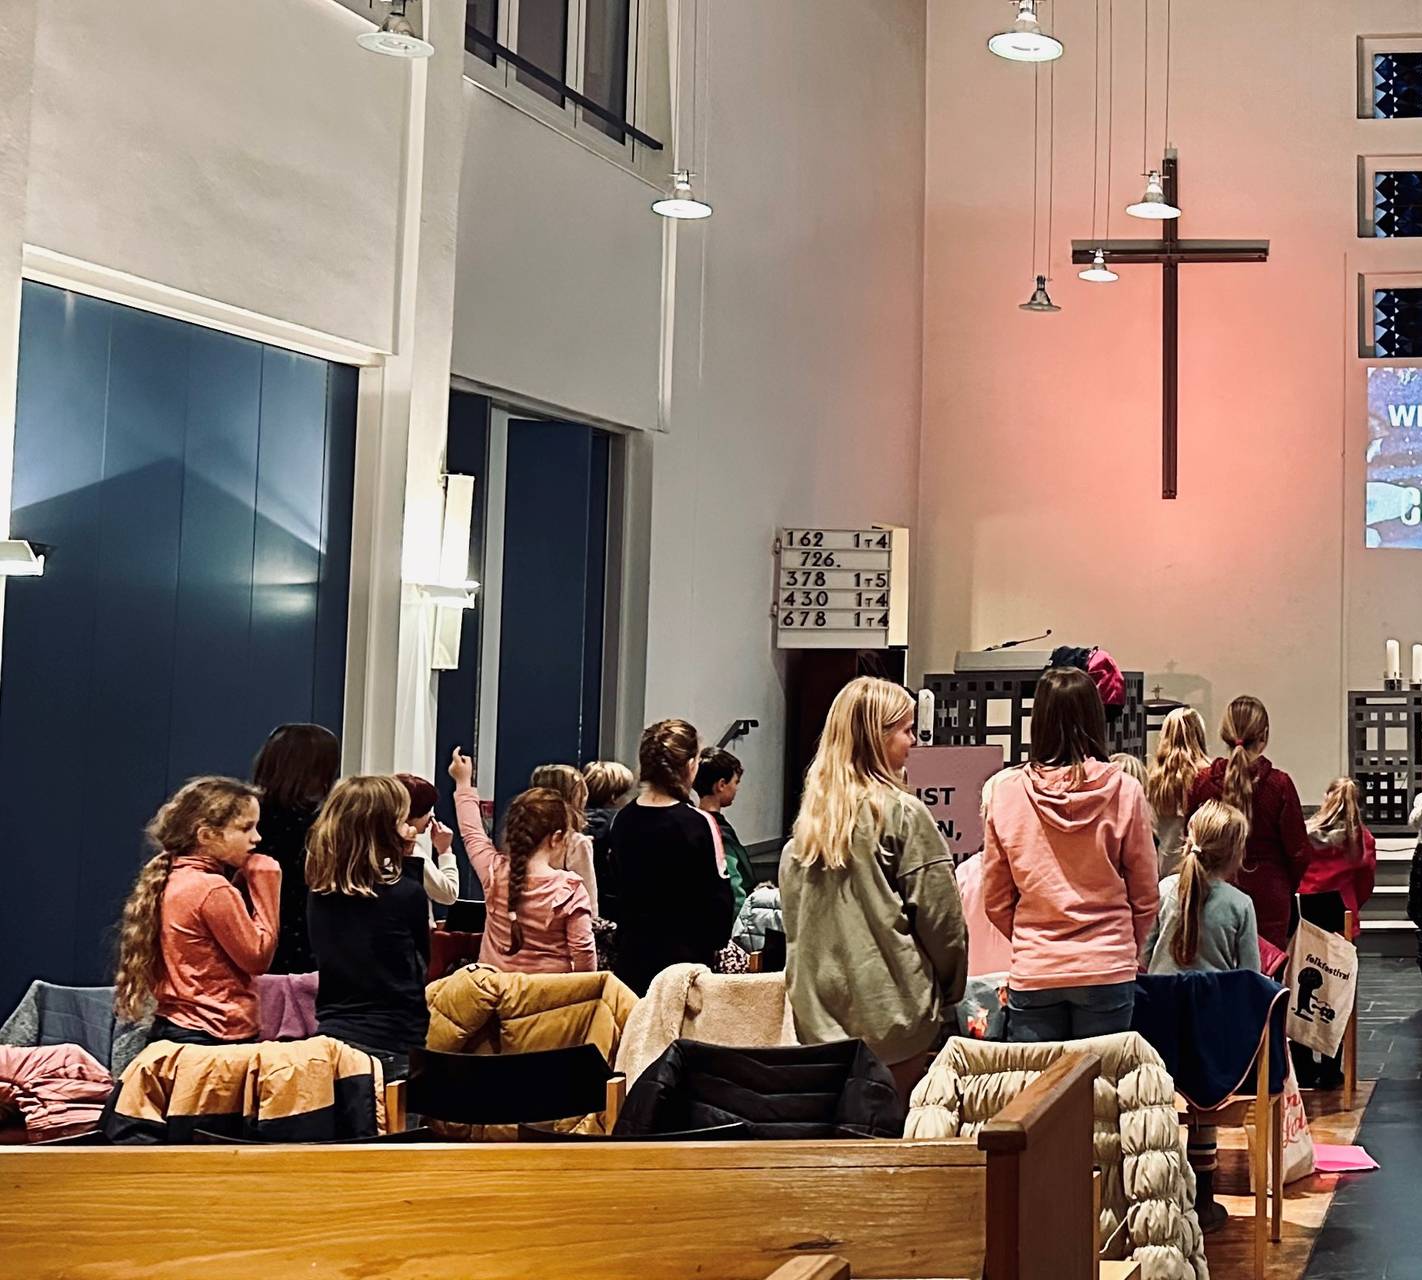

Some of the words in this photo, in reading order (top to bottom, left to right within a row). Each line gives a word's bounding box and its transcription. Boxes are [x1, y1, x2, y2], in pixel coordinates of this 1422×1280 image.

[786, 531, 824, 548] 162
[786, 571, 826, 587] 378
[783, 590, 829, 607] 430
[783, 611, 827, 627] 678
[1305, 953, 1350, 980] folkfestival
